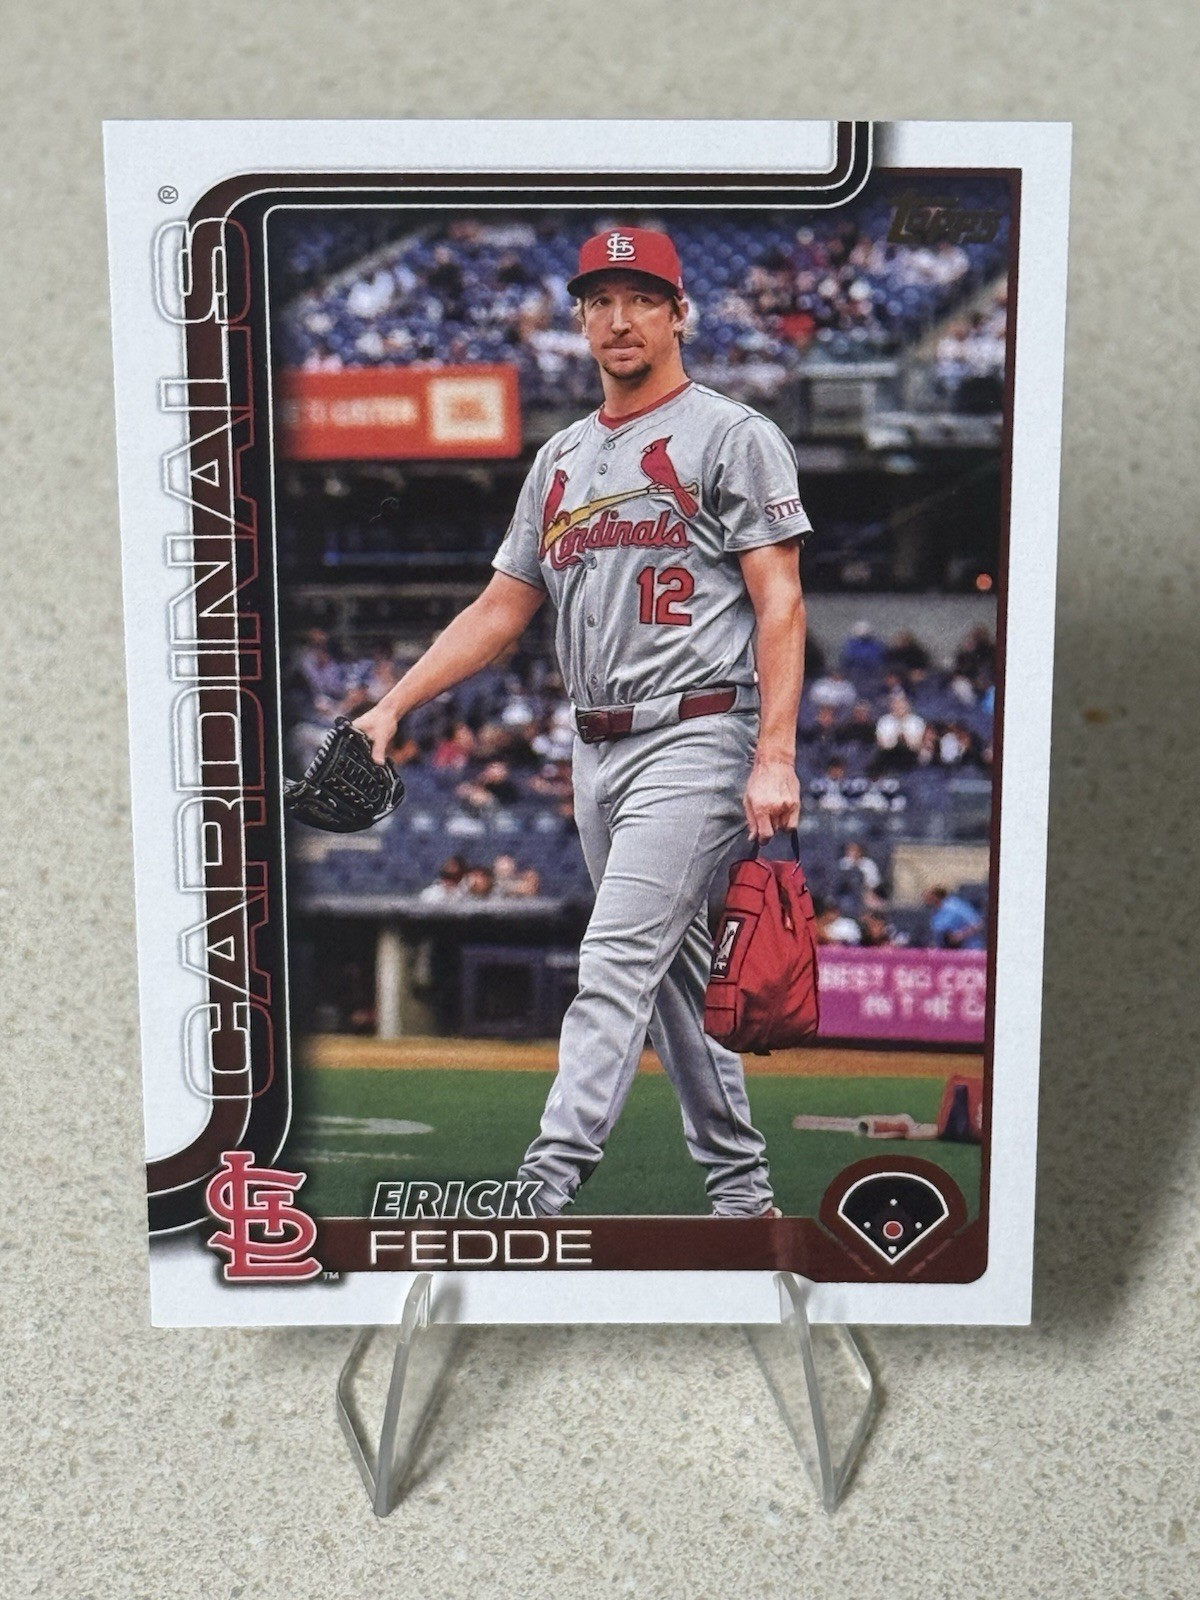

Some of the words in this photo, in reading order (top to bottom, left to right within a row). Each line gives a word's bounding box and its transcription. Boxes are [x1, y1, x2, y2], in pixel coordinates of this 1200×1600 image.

[549, 508, 693, 572] Cardinals
[637, 566, 695, 627] 12
[154, 216, 275, 1099] CARDINALS
[370, 1180, 545, 1220] ERICK
[369, 1230, 593, 1266] FEDDE
